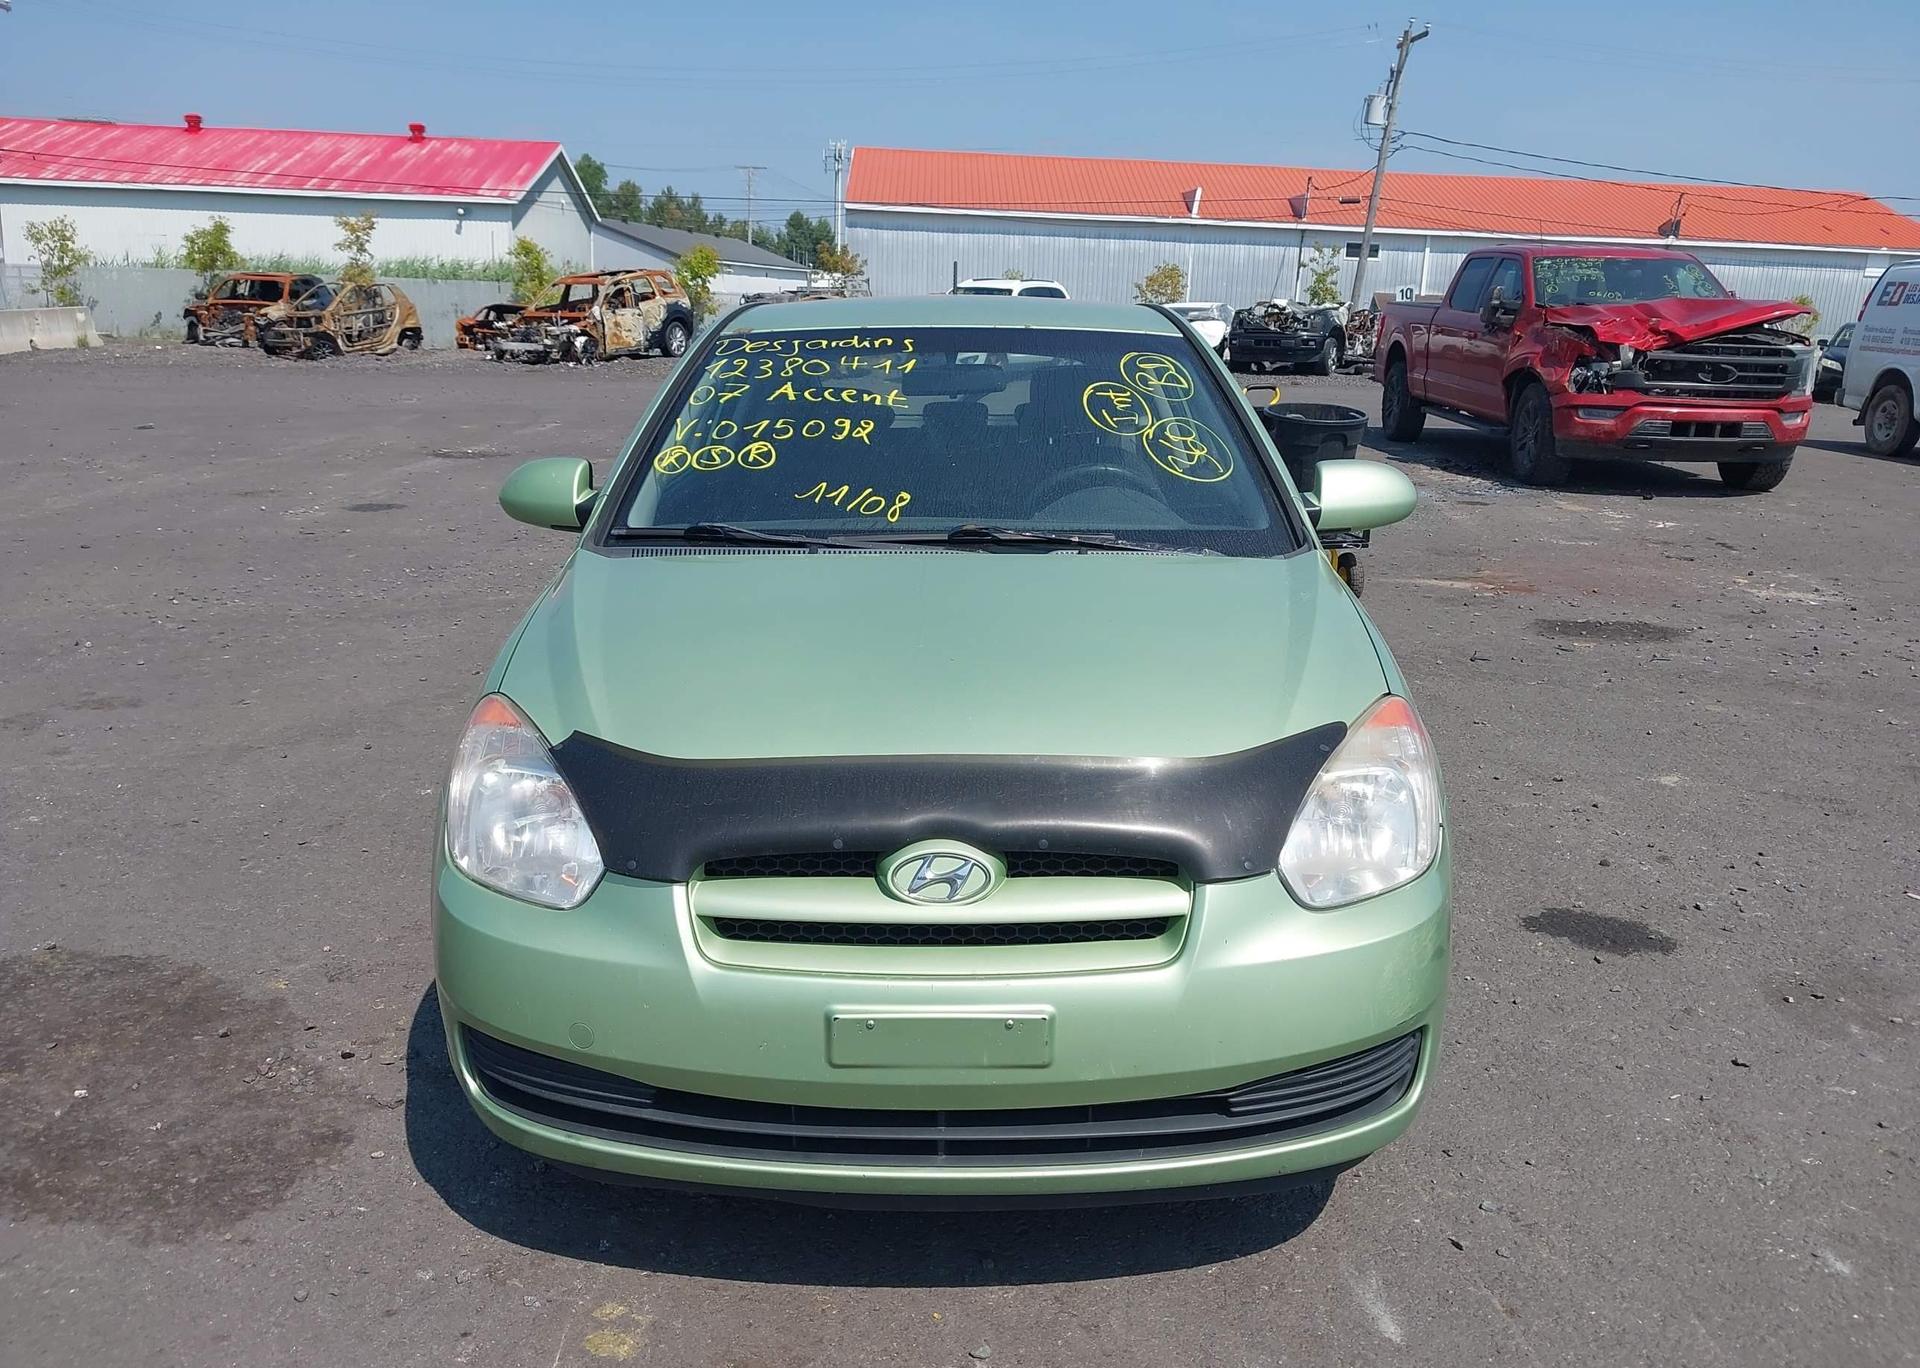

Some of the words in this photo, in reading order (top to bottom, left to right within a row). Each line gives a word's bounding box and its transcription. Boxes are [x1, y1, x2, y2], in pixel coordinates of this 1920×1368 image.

[1877, 282, 1909, 306] ED
[704, 355, 917, 380] 12380411
[689, 383, 751, 406] 07
[766, 381, 910, 409] Accent
[794, 481, 912, 523] 11/08
